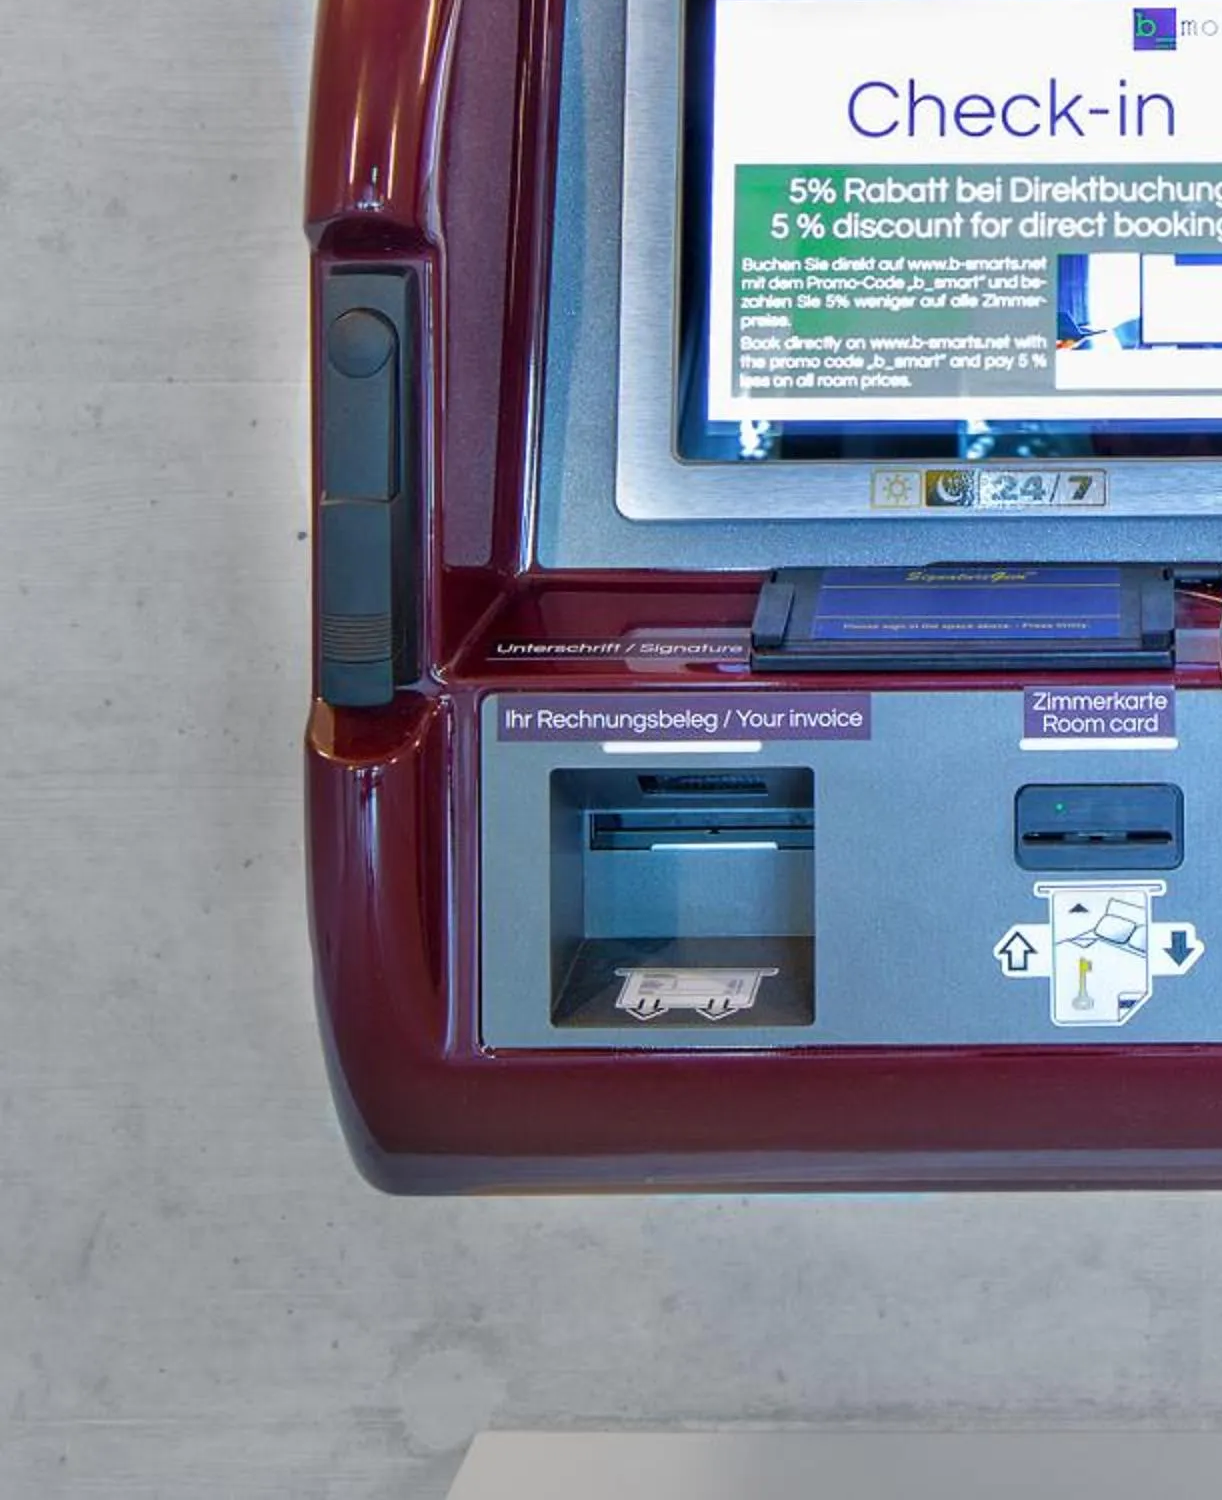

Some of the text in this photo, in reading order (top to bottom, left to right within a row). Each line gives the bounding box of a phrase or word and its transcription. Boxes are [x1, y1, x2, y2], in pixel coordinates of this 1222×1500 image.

[847, 78, 1175, 137] Check-in
[789, 177, 836, 203] 5%
[844, 176, 948, 203] Rabatt
[956, 176, 1002, 202] bei
[832, 212, 963, 239] discount
[970, 211, 1011, 238] for
[1018, 211, 1107, 238] direct
[742, 257, 801, 272] Buchen
[804, 257, 829, 271] Sie
[832, 256, 875, 271] direkt
[878, 257, 904, 271] auf
[741, 276, 766, 290] mit
[768, 276, 804, 290] dem
[806, 276, 905, 290] Promo-Code
[988, 275, 1018, 289] und
[741, 295, 792, 309] zahlen
[797, 294, 821, 308] Sie
[825, 294, 851, 308] 5%
[854, 295, 915, 311] weniger
[919, 294, 947, 308] auf
[950, 294, 978, 308] alle
[740, 336, 780, 350] Book
[783, 336, 842, 353] directly
[845, 338, 866, 350] on
[1014, 334, 1048, 349] with
[740, 354, 766, 369] the
[769, 356, 821, 372] promo
[823, 355, 864, 369] code
[949, 354, 981, 368] and
[983, 356, 1014, 371] pay
[772, 376, 793, 388] on
[817, 376, 858, 388] room
[992, 472, 1093, 502] 24/7
[497, 643, 621, 654] Unterschrift
[639, 643, 743, 655] Signature
[1032, 692, 1168, 711] Zimmerkarte
[505, 709, 532, 728] Ihr
[537, 708, 719, 733] Rechnungsbeleg
[736, 709, 785, 728] Your
[789, 708, 863, 728] invoice
[1043, 713, 1159, 733] Room card
